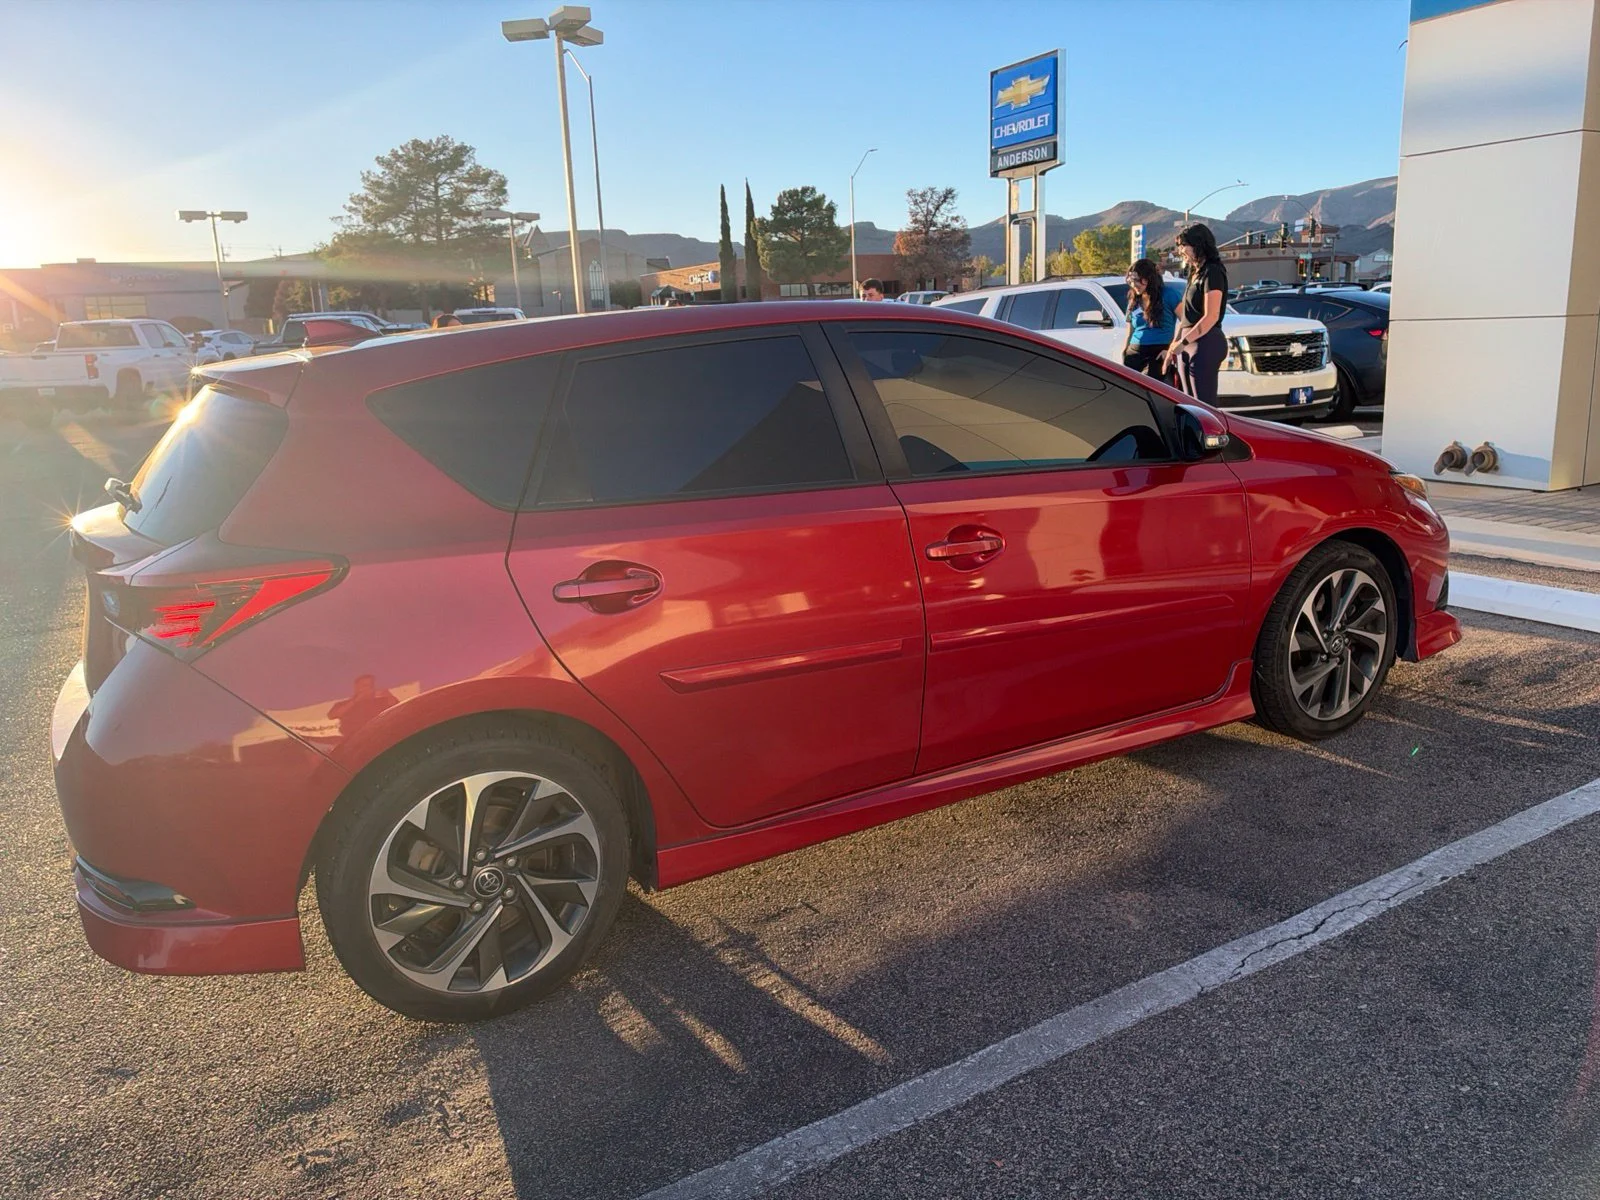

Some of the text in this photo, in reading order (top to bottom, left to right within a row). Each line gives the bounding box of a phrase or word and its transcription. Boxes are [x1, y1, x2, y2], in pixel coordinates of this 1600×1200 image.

[994, 113, 1050, 139] CHEVROLET
[997, 146, 1048, 168] ANDERSON
[689, 272, 709, 285] CHASE
